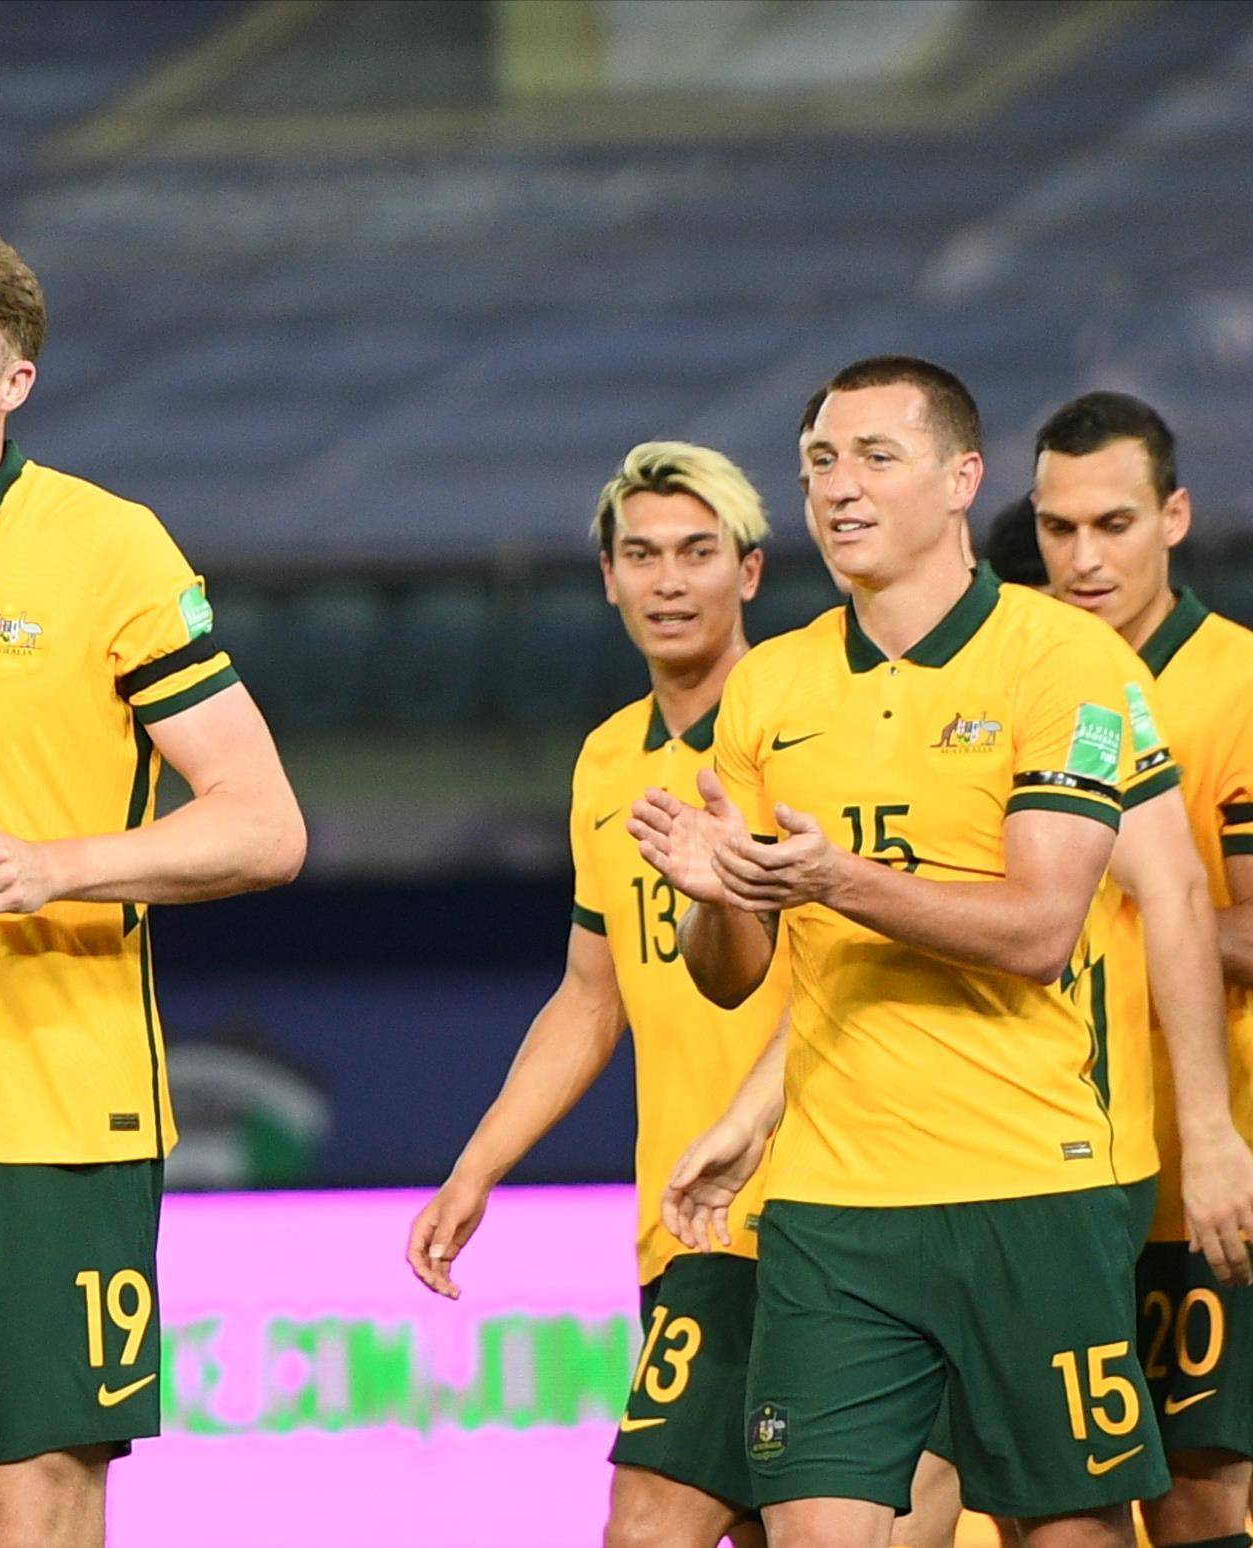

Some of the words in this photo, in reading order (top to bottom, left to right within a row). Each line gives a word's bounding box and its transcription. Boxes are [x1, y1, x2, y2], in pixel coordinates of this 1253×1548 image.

[841, 804, 918, 873] 15
[631, 876, 679, 963] 13
[75, 1269, 152, 1367] 19
[633, 1305, 702, 1403] 13
[1143, 1287, 1224, 1378] 20
[1051, 1341, 1140, 1439] 15
